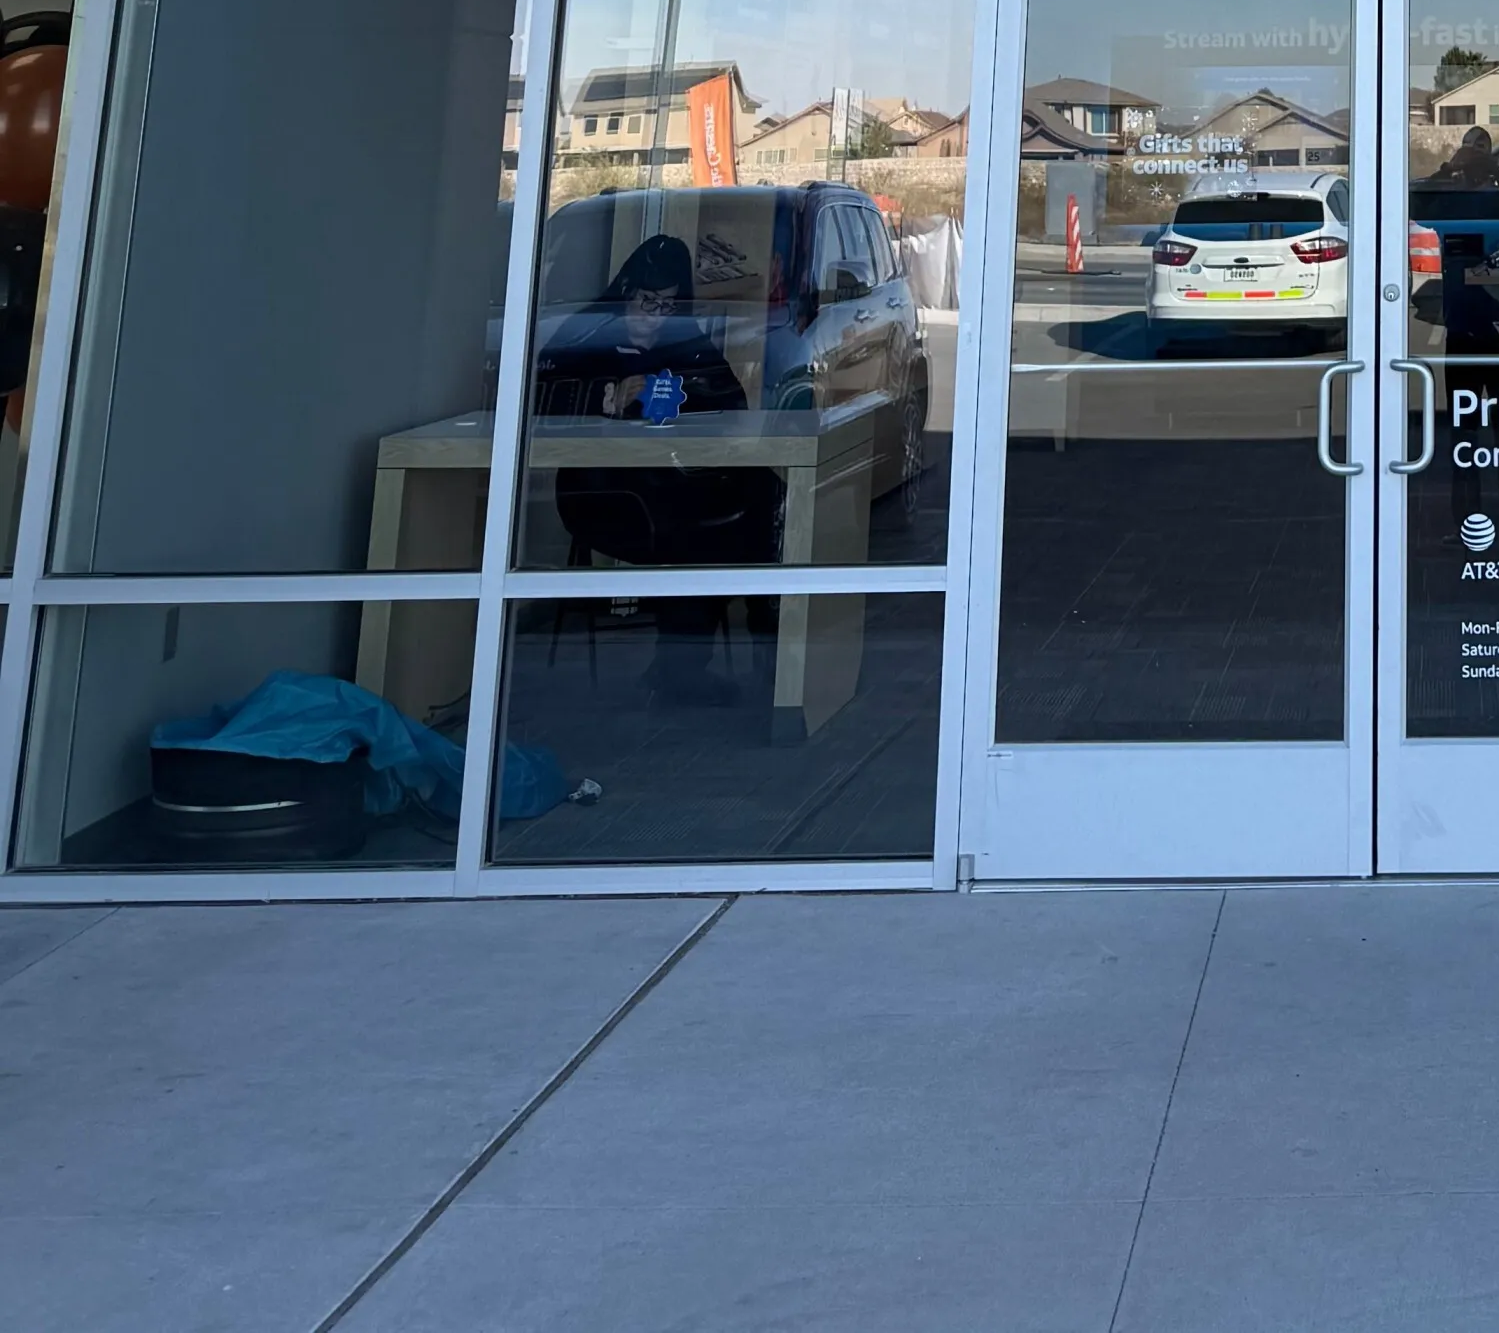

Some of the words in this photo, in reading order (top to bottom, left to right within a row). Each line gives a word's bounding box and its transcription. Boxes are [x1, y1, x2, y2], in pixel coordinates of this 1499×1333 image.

[1163, 29, 1246, 49] Stream
[1252, 26, 1303, 48] with
[1139, 133, 1193, 153] Gifts
[1199, 132, 1245, 153] that
[1132, 156, 1219, 175] connect
[1224, 158, 1249, 174] us
